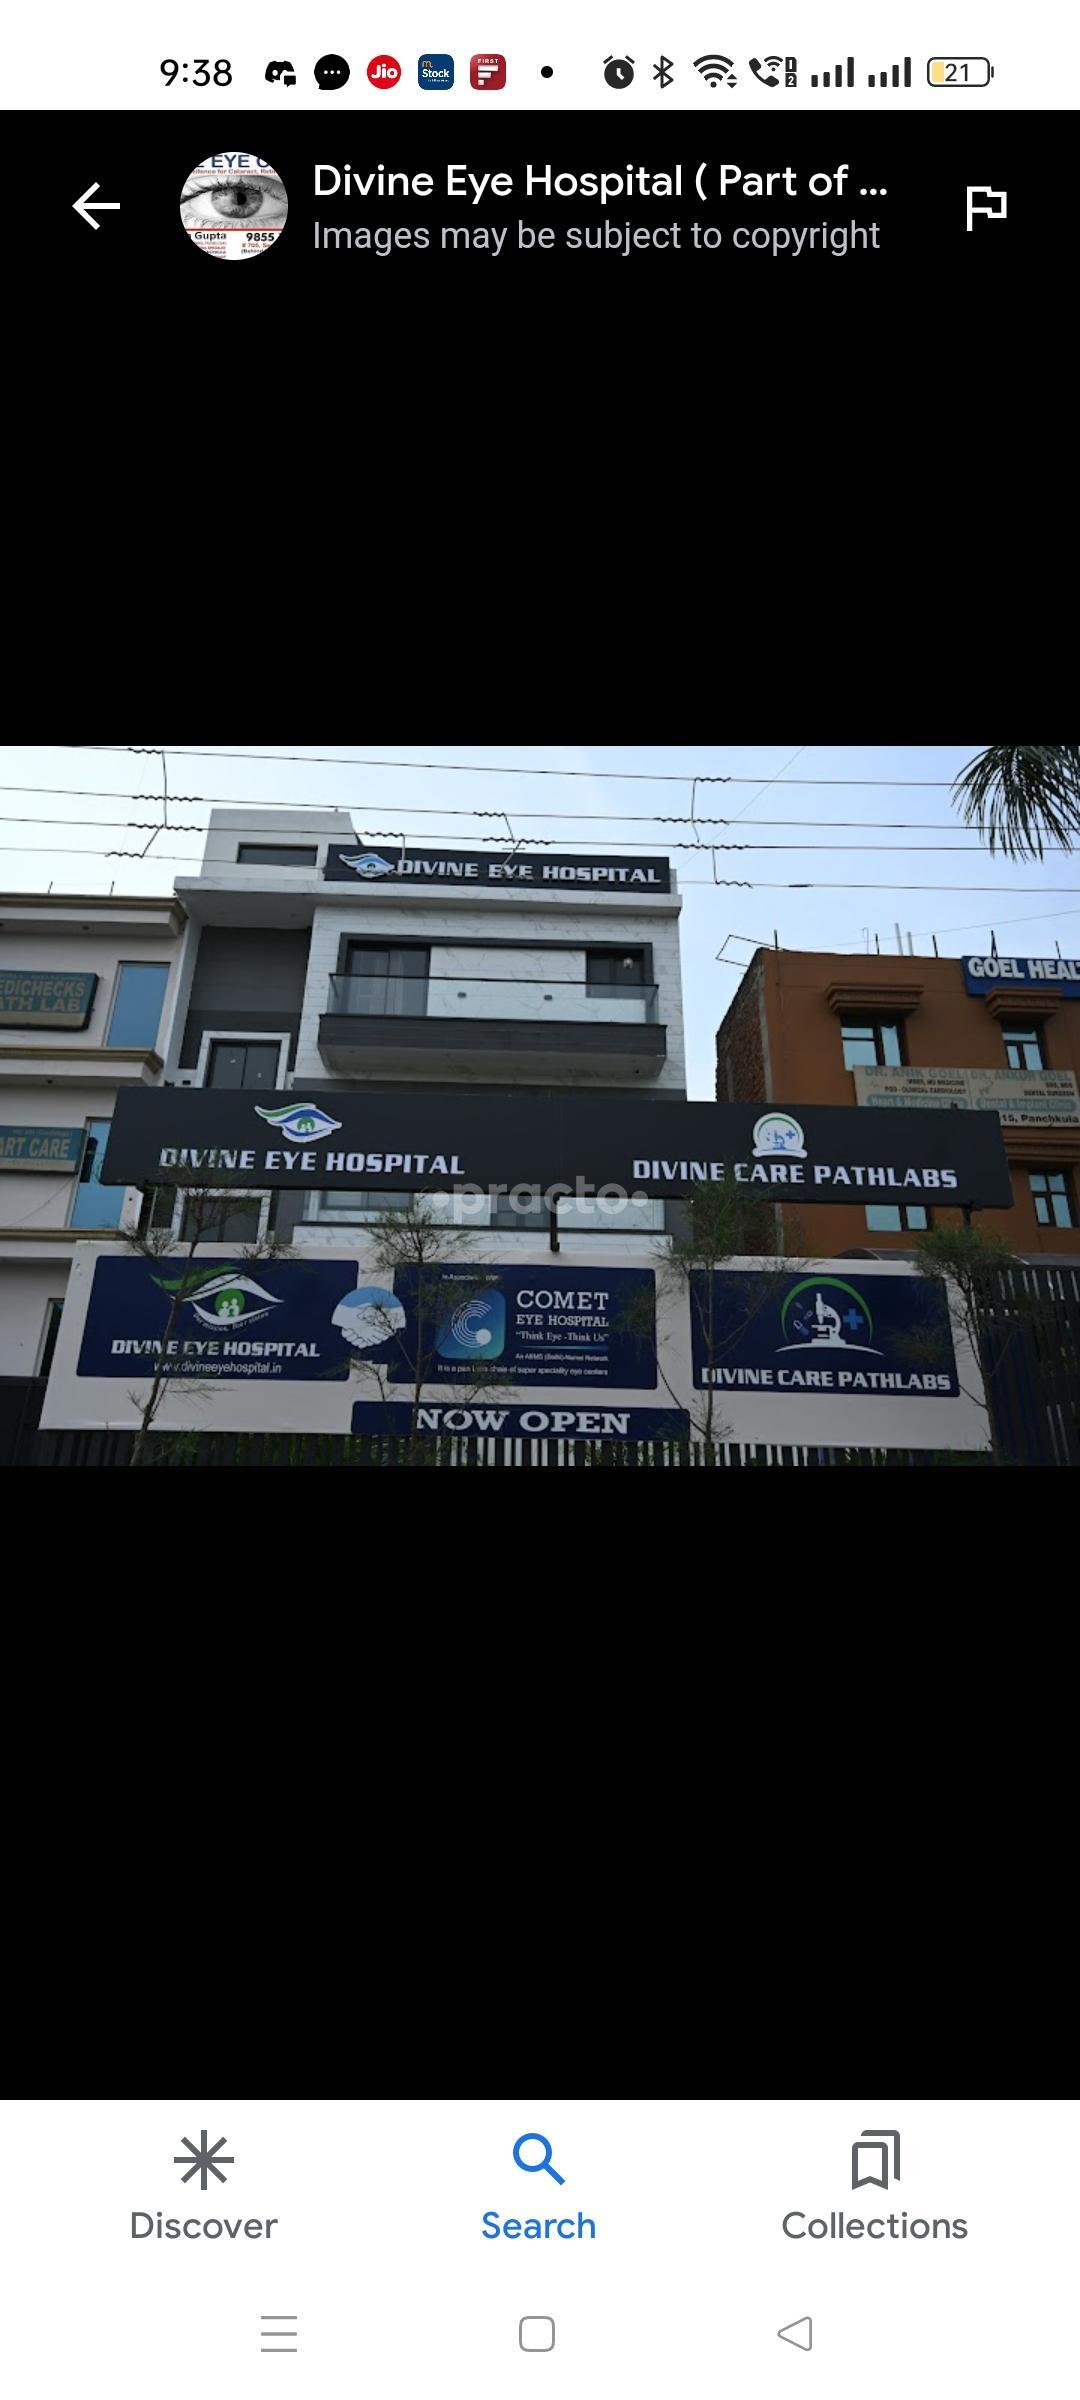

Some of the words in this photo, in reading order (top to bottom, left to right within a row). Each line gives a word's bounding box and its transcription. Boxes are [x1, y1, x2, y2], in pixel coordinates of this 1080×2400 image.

[160, 59, 232, 86] 9:38
[371, 64, 398, 79] Jio
[422, 69, 450, 78] Stock
[945, 63, 969, 82] 21
[212, 155, 249, 168] EYE
[315, 164, 433, 196] Divine
[448, 165, 513, 204] Eye
[527, 164, 681, 204] Hospital
[696, 162, 707, 201] (
[721, 165, 796, 196] Part
[809, 164, 848, 196] of
[195, 232, 226, 241] Gupta
[246, 233, 274, 242] 9855
[315, 222, 429, 256] Images
[442, 228, 507, 256] may
[519, 220, 554, 248] be
[567, 220, 681, 256] subject
[691, 223, 721, 248] to
[733, 220, 880, 256] copyright
[399, 859, 478, 878] DIVINE
[488, 864, 534, 881] EYE
[543, 865, 662, 884] HOSPITAL
[968, 957, 1025, 979] GOEL
[40, 998, 80, 1012] LAB
[1021, 1114, 1080, 1124] Panchkula
[28, 1138, 71, 1158] CARE
[159, 1148, 256, 1169] DIVINE
[264, 1151, 317, 1171] EYE
[325, 1152, 465, 1175] HOSPITAL
[633, 1160, 725, 1182] DIVINE
[735, 1163, 805, 1184] CARE
[814, 1165, 958, 1189] PATHLABS
[516, 1290, 609, 1310] COMET
[516, 1314, 543, 1326] EYE
[548, 1315, 609, 1327] HOSPITAL
[547, 1332, 562, 1342] Eye
[111, 1340, 178, 1354] DIVINE
[183, 1341, 219, 1356] EYE
[223, 1342, 320, 1357] HOSPITAL
[701, 1367, 773, 1385] DIVINE
[777, 1369, 834, 1387] CARE
[838, 1371, 951, 1390] PATHLABS
[416, 1409, 510, 1431] NOW
[519, 1411, 631, 1434] OPEN
[130, 2211, 278, 2240] Discover
[482, 2211, 596, 2240] Search
[783, 2211, 968, 2240] Collections
